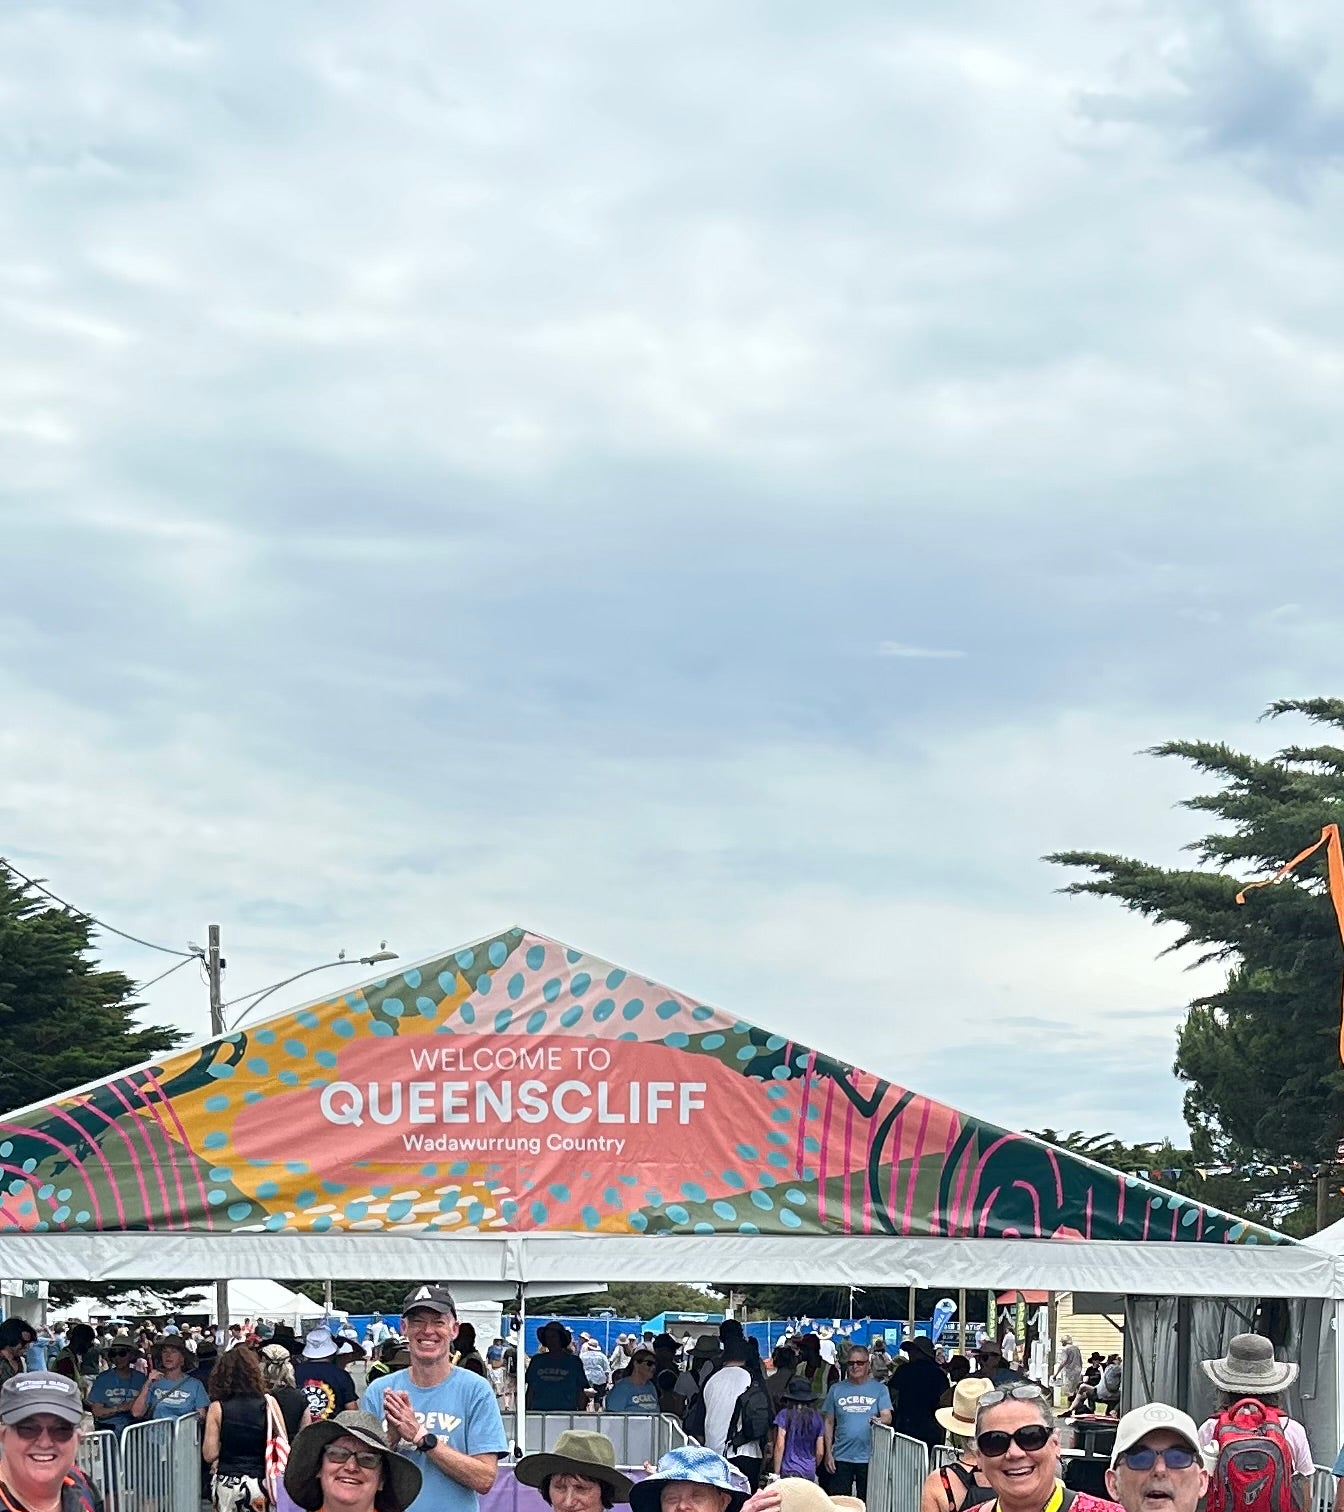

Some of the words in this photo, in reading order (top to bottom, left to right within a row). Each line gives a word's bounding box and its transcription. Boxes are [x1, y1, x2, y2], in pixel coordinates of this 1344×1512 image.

[410, 1048, 562, 1072] WELCOME
[571, 1047, 611, 1071] TO
[320, 1081, 707, 1127] QUEENSCLIFF
[403, 1134, 541, 1154] Wadawurrung
[547, 1134, 626, 1155] Country
